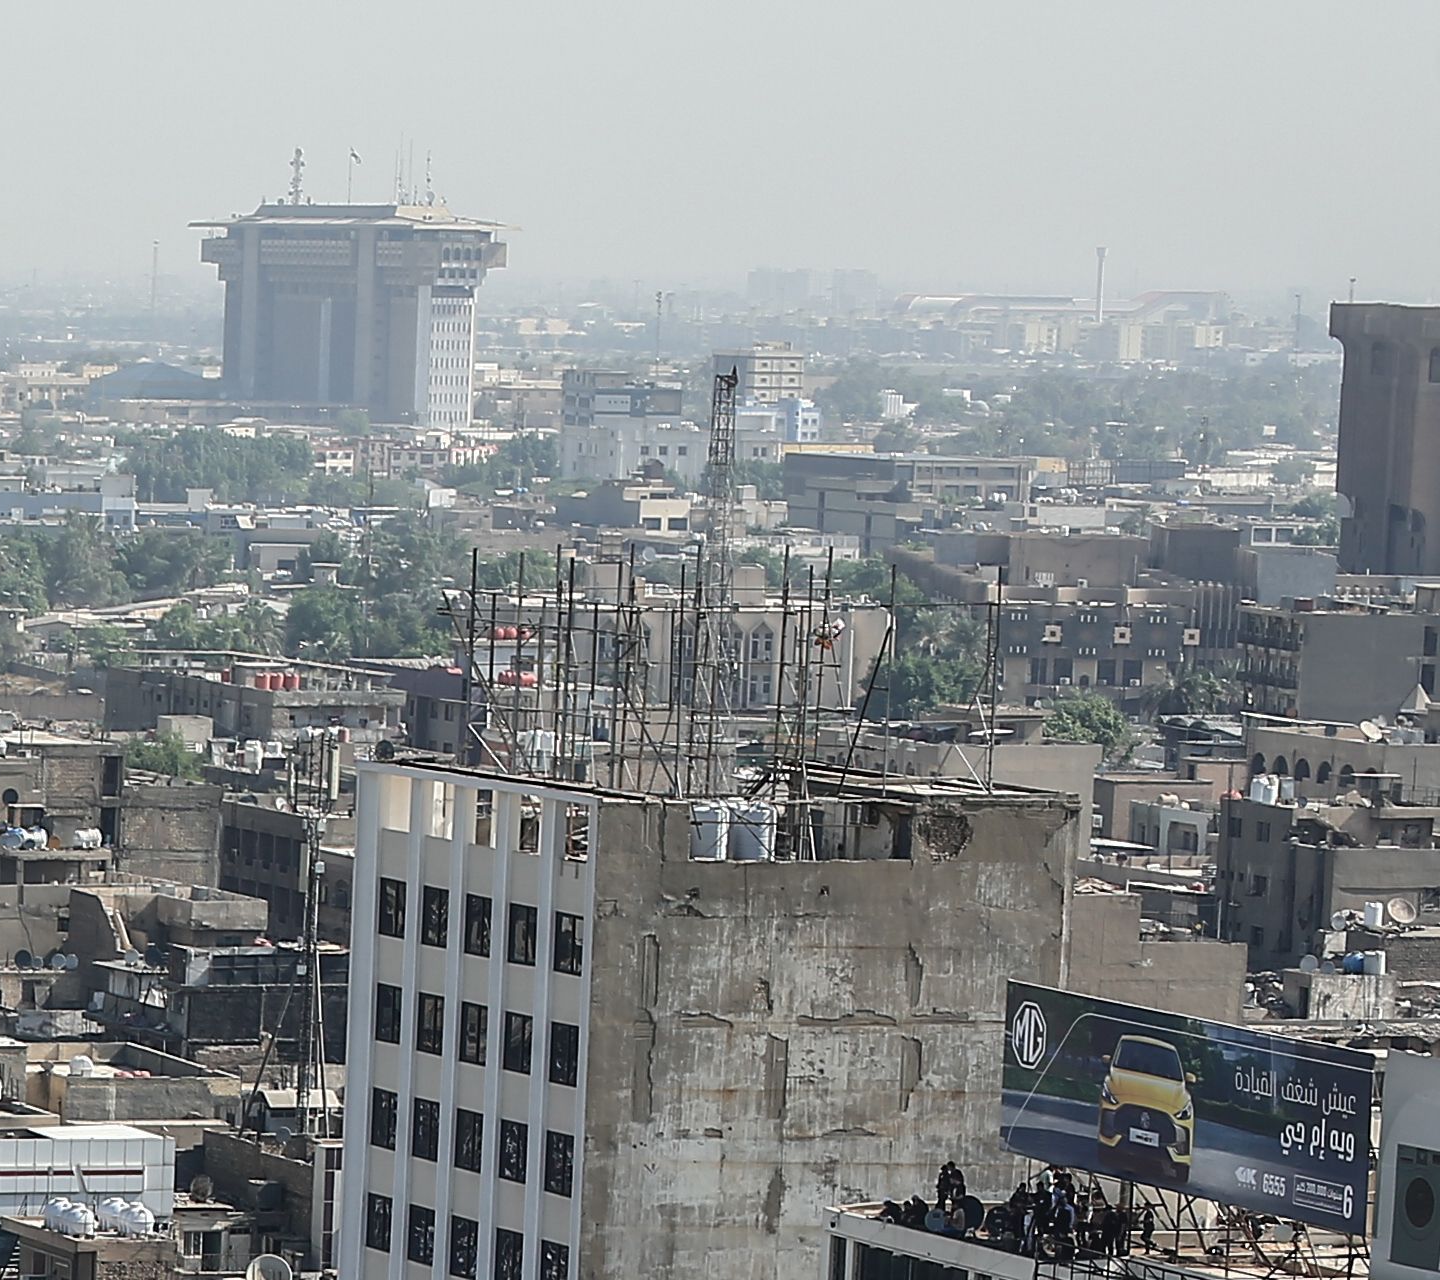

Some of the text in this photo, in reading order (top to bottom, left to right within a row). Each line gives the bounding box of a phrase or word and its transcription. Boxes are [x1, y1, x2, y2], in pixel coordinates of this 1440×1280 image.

[1015, 1006, 1044, 1064] MG
[1234, 1065, 1357, 1116] عيش شغف القيادة
[1280, 1119, 1307, 1156] جي
[1262, 1173, 1286, 1197] 6555
[1342, 1184, 1354, 1219] 6
